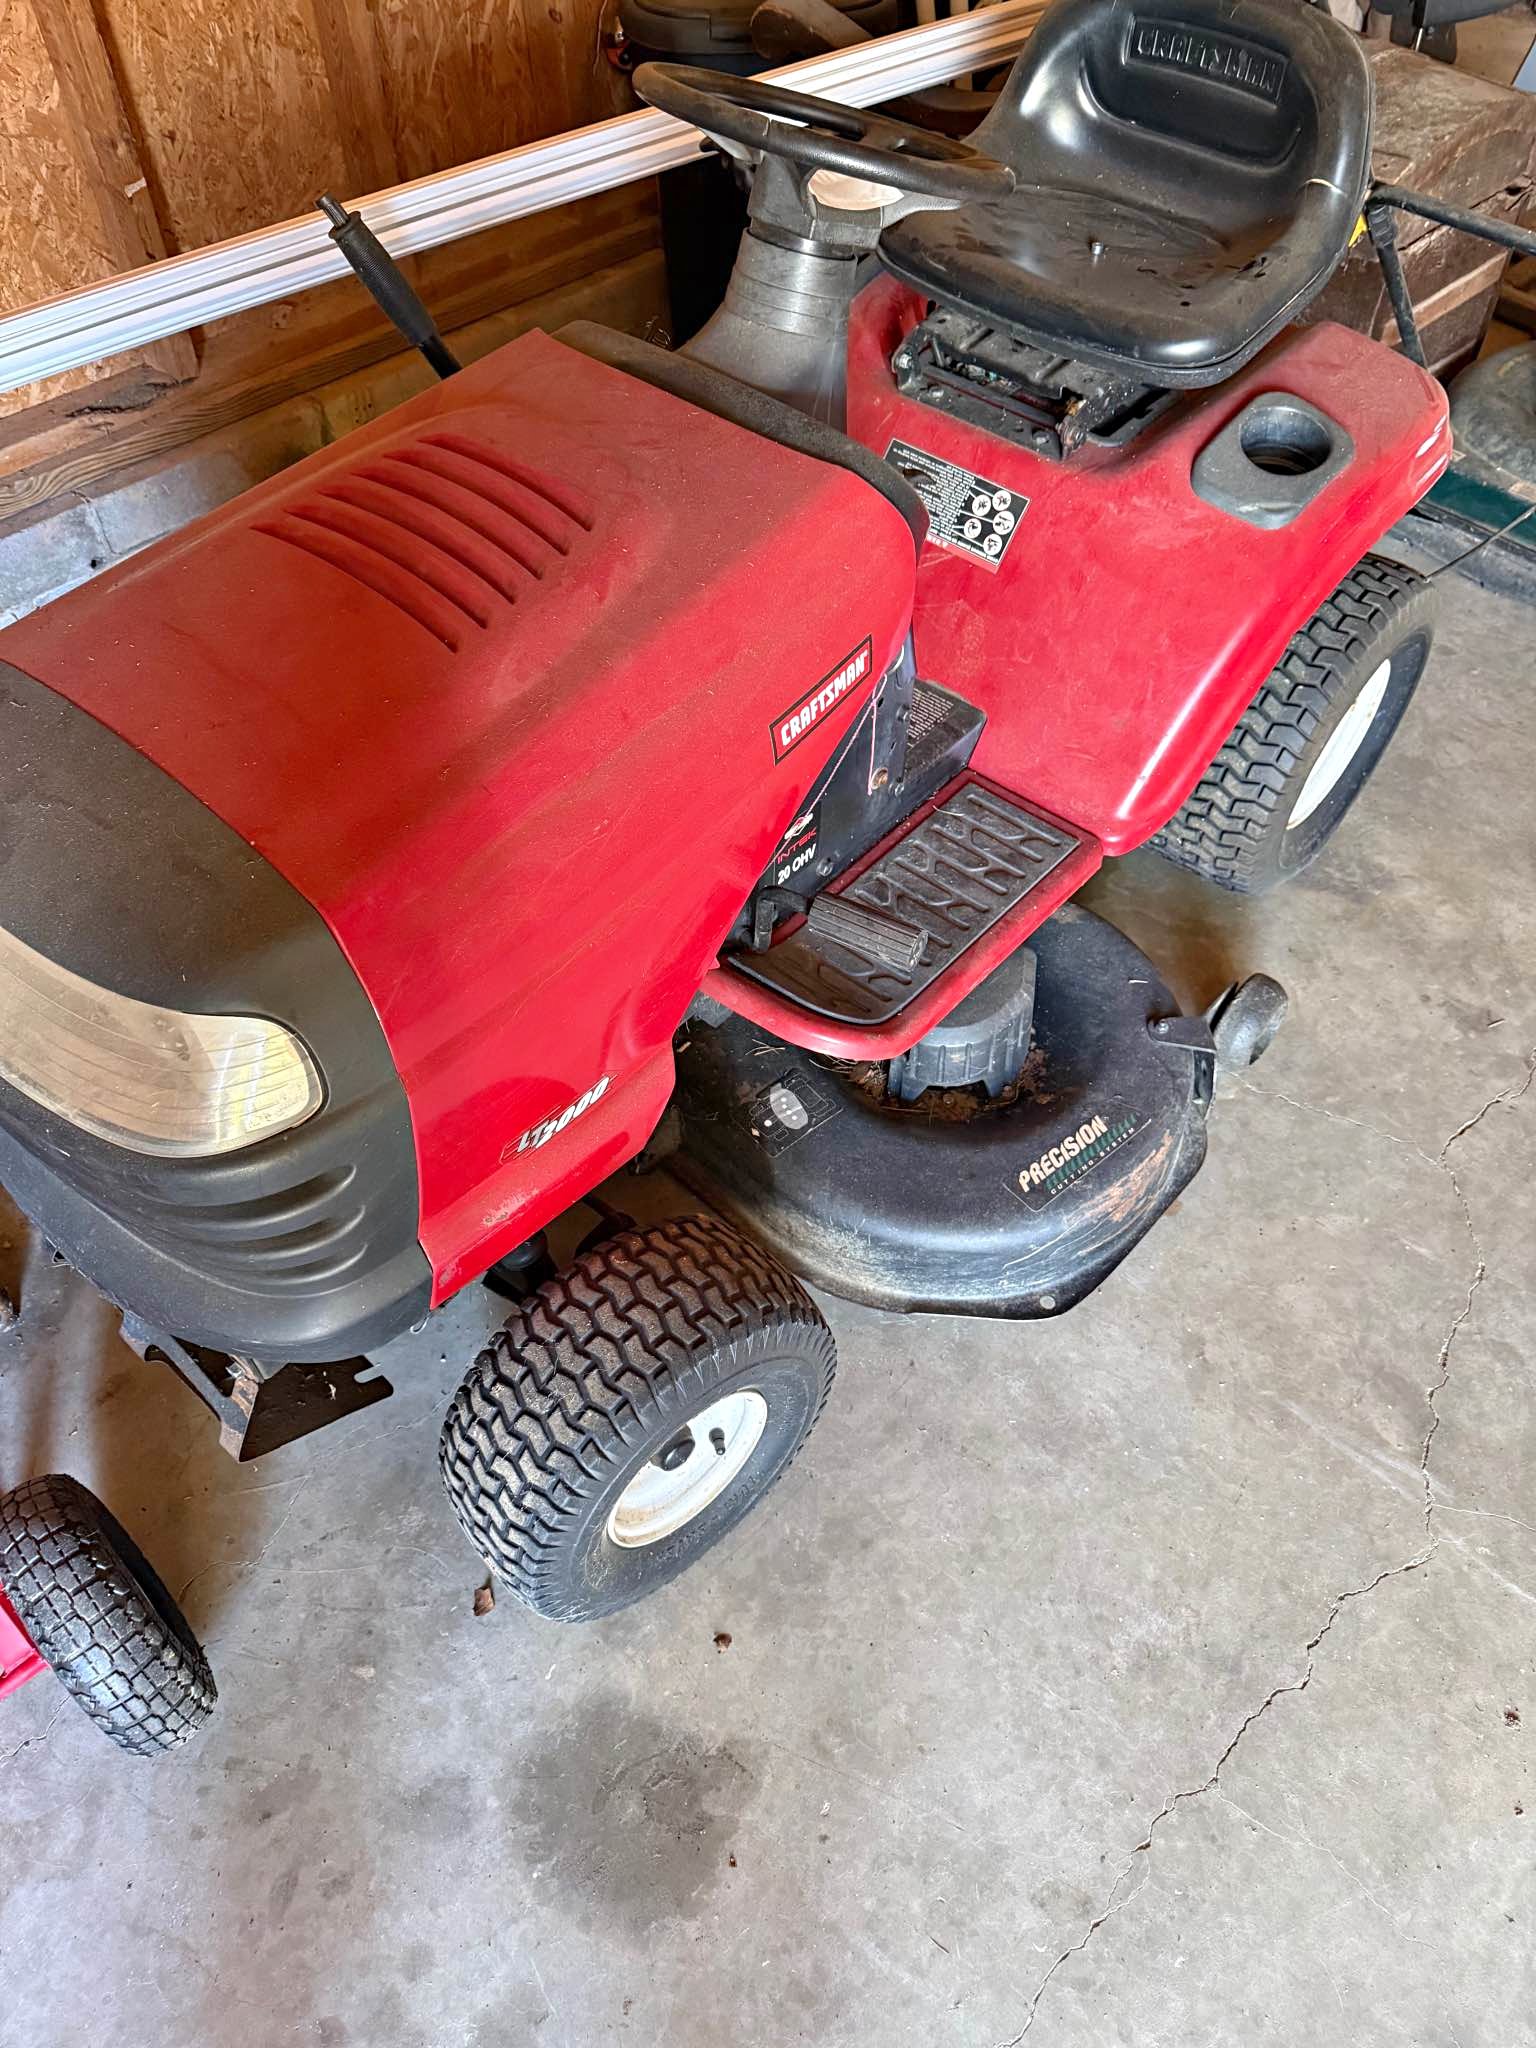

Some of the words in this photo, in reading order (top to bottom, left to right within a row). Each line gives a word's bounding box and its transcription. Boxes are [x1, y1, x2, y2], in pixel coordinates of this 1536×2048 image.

[1137, 28, 1278, 93] CRAFTSMAN
[781, 649, 868, 746] CRAFTSMAN
[777, 827, 817, 865] INTEK
[777, 865, 791, 885] 20
[792, 843, 817, 872] OHV
[1018, 1114, 1109, 1193] PRECISION
